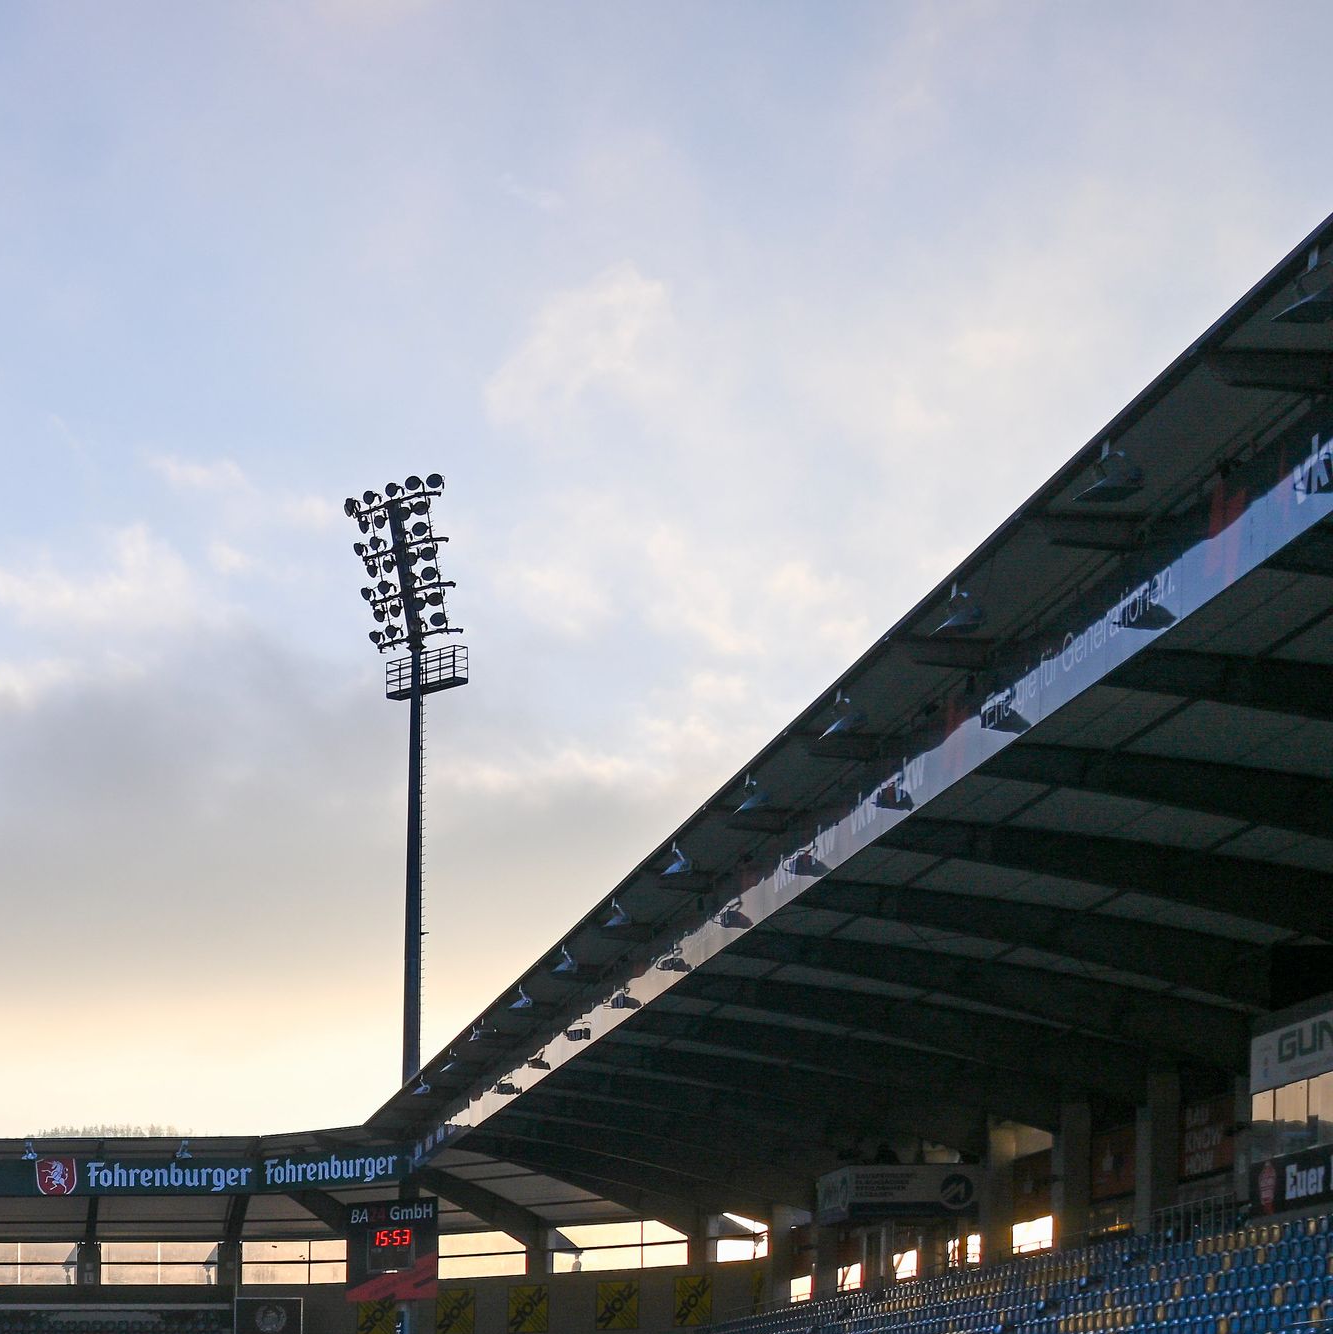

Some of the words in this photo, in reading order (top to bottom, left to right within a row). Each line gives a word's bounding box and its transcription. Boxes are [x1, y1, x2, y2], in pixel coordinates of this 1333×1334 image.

[1293, 433, 1333, 505] vk
[985, 665, 1037, 729] Energie
[1040, 648, 1060, 690] für
[86, 1162, 252, 1192] Fohrenburger
[263, 1153, 398, 1184] Fohrenburger
[1285, 1163, 1325, 1201] Euer
[389, 1203, 433, 1221] GmbH
[375, 1229, 412, 1247] 15:53
